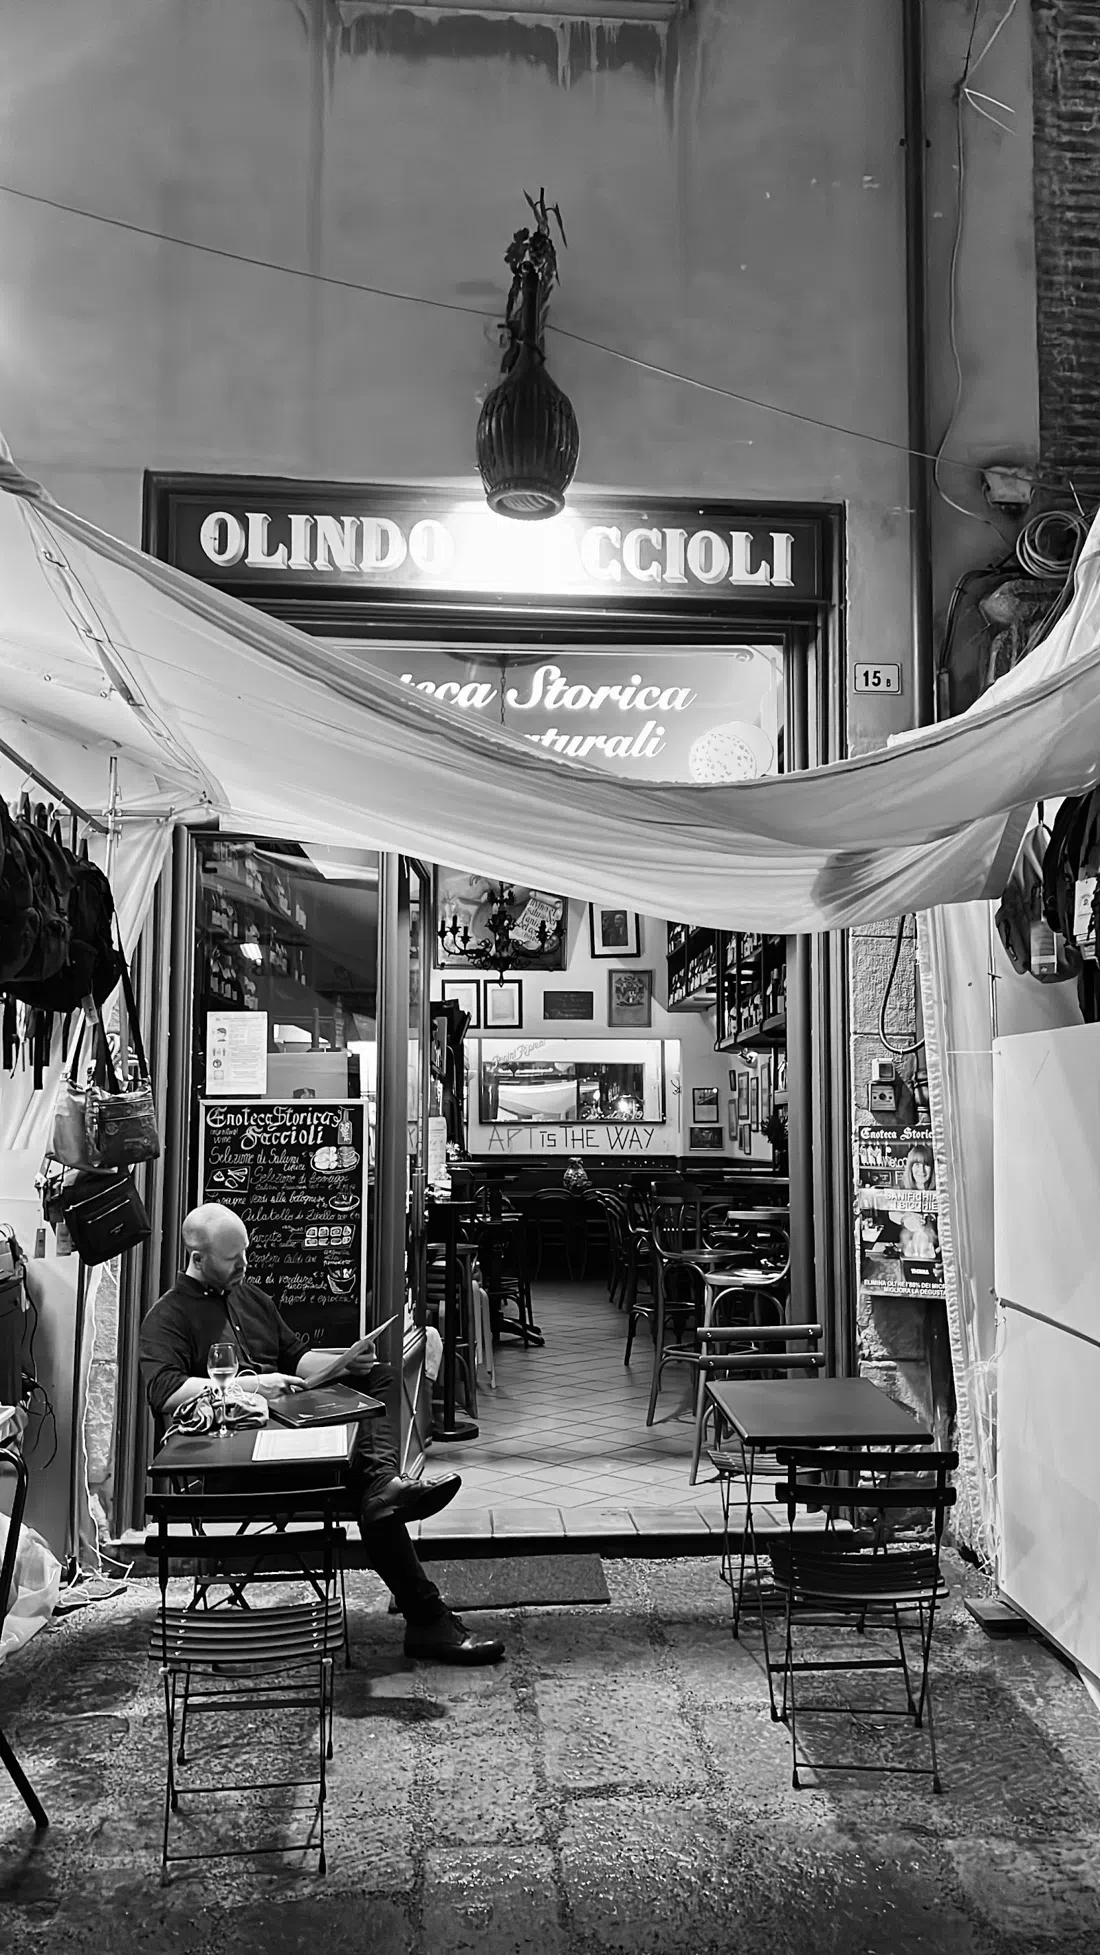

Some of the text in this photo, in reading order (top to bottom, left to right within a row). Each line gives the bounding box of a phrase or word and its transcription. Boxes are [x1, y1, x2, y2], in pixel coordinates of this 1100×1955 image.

[200, 511, 795, 587] OLINDO CCIOLI
[506, 665, 698, 710] Storica
[863, 670, 891, 688] 15 B
[524, 720, 667, 757] turali
[206, 1106, 337, 1130] Enoteca Storica
[240, 1125, 324, 1150] Faccioli
[559, 1125, 600, 1149] THE
[606, 1126, 654, 1150] WAY
[861, 1127, 897, 1139] Enoteca
